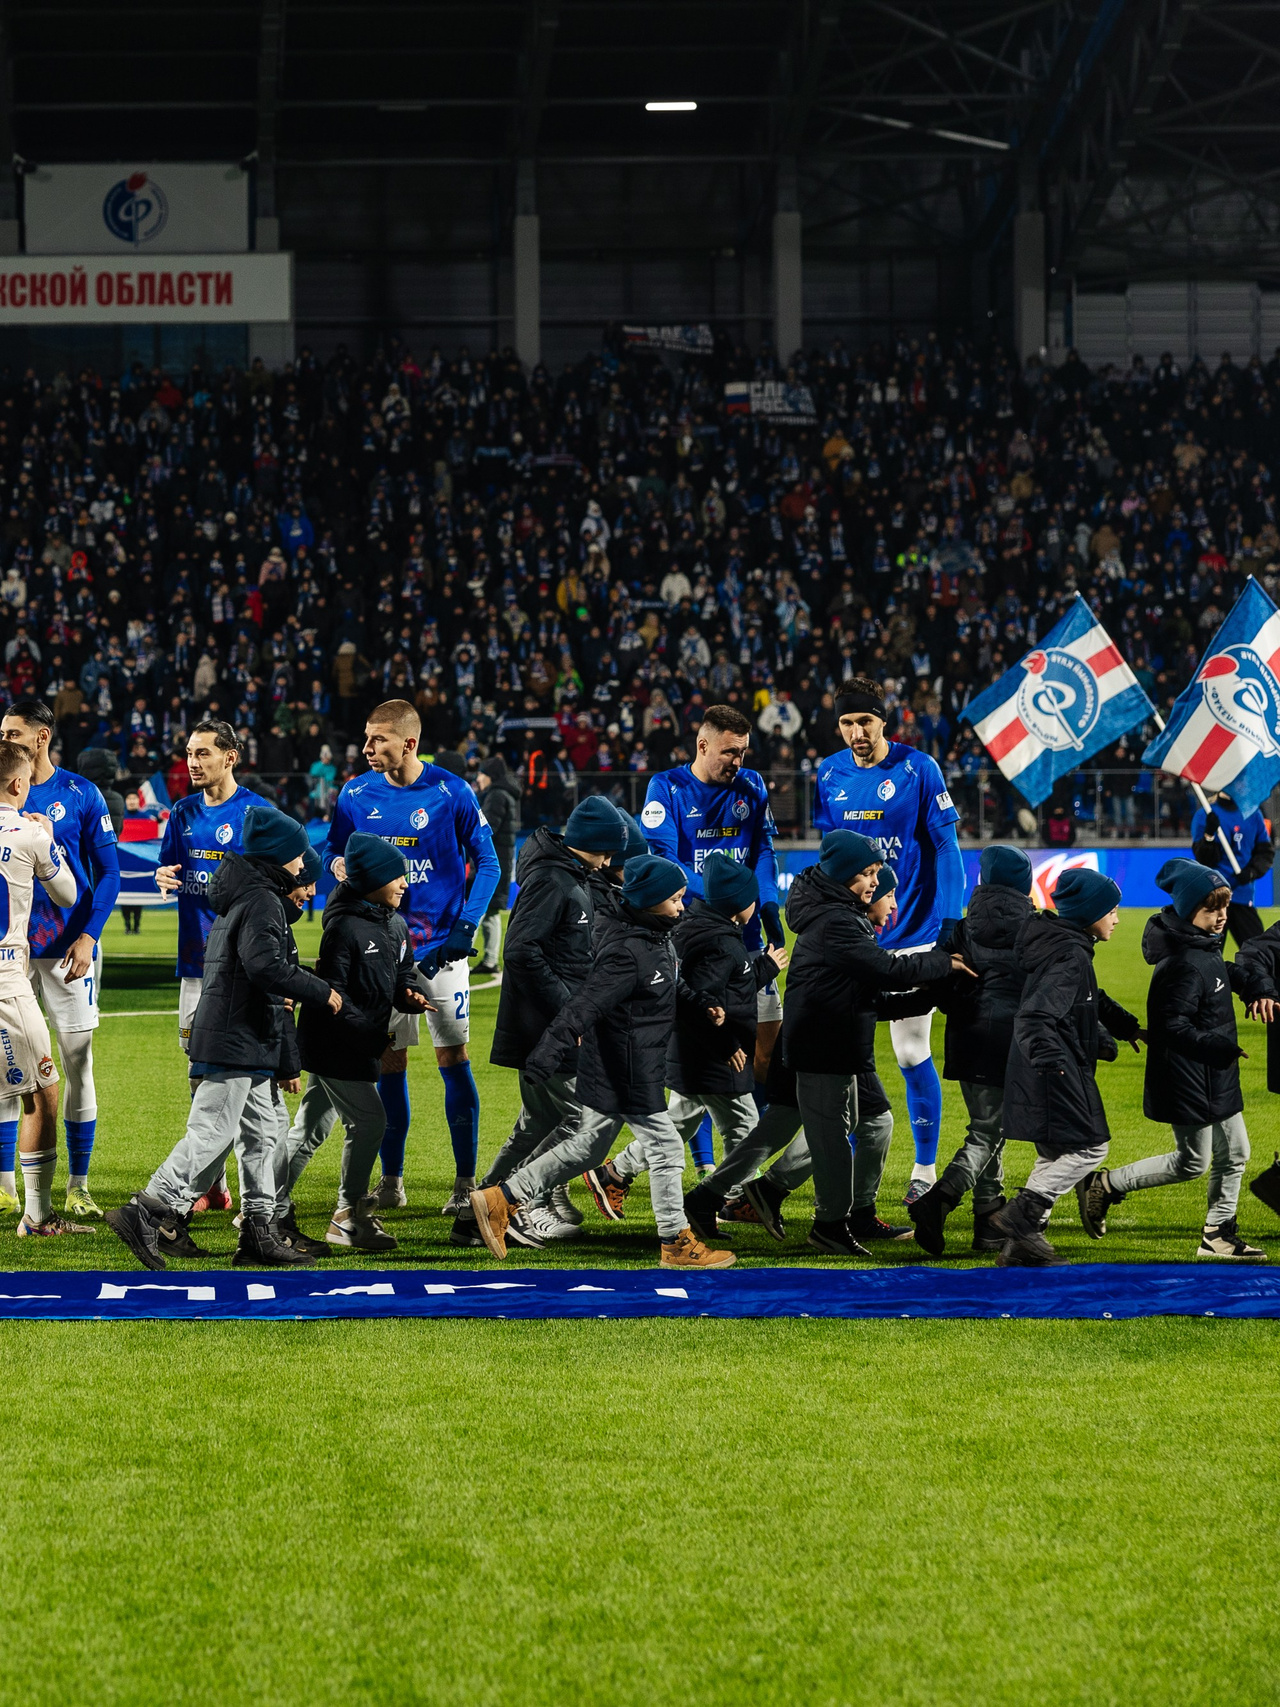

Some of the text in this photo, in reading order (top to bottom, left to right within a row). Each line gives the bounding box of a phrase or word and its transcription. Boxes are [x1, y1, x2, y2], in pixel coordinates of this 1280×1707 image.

[95, 271, 233, 306] ОБЛАСТИ
[843, 810, 886, 821] МЕЛБЕТ
[188, 848, 225, 861] МЕЛБЕТ
[0, 1028, 17, 1067] РОССЕТИ
